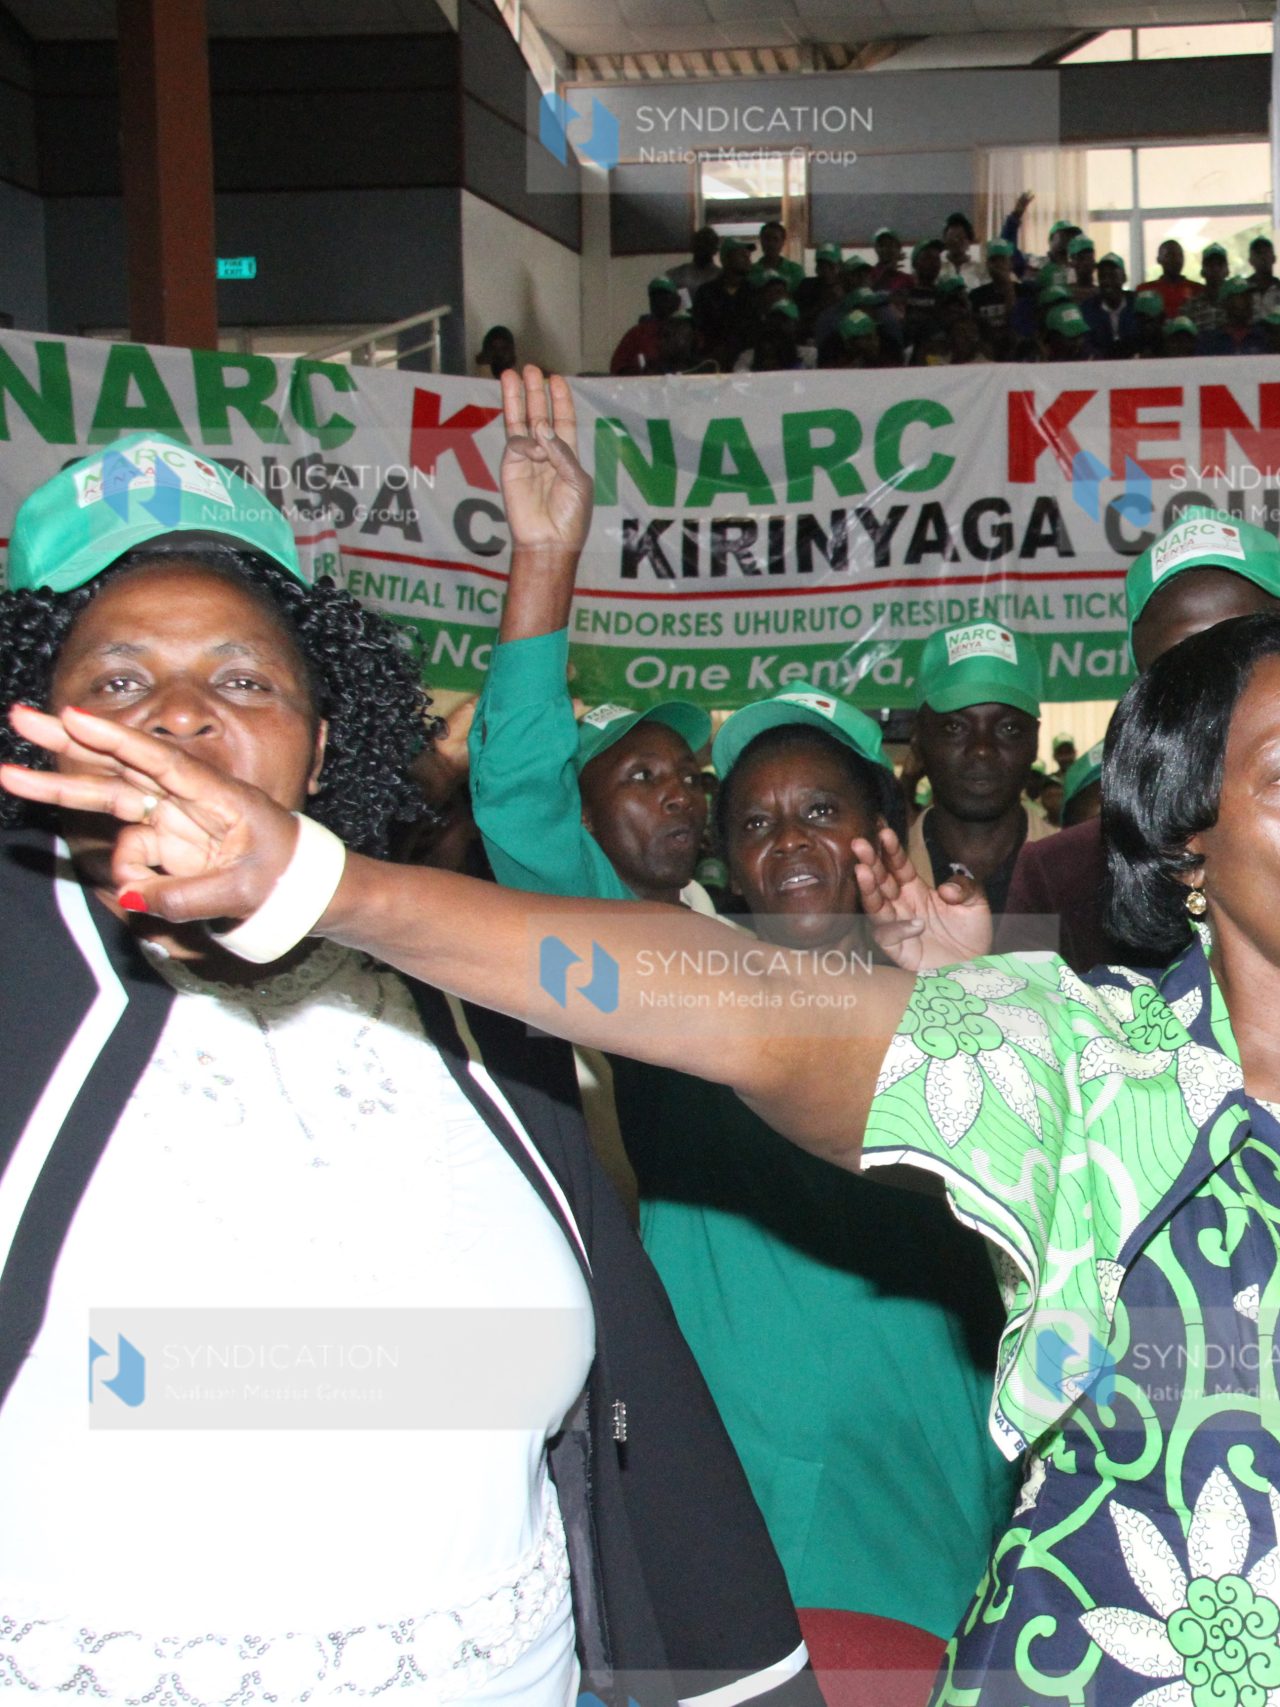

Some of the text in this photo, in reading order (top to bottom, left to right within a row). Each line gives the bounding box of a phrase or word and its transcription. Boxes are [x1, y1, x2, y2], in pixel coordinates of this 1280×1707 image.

[0, 341, 358, 450] NARC
[82, 448, 187, 489] NARC
[594, 399, 957, 509] NARC
[619, 496, 1076, 580] KIRINYAGA
[1154, 523, 1217, 558] NARC
[574, 608, 724, 639] ENDORSES
[734, 603, 862, 637] UHURUTO
[872, 593, 1054, 628] PRESIDENTIAL
[949, 629, 997, 649] NARC
[625, 656, 731, 691] One
